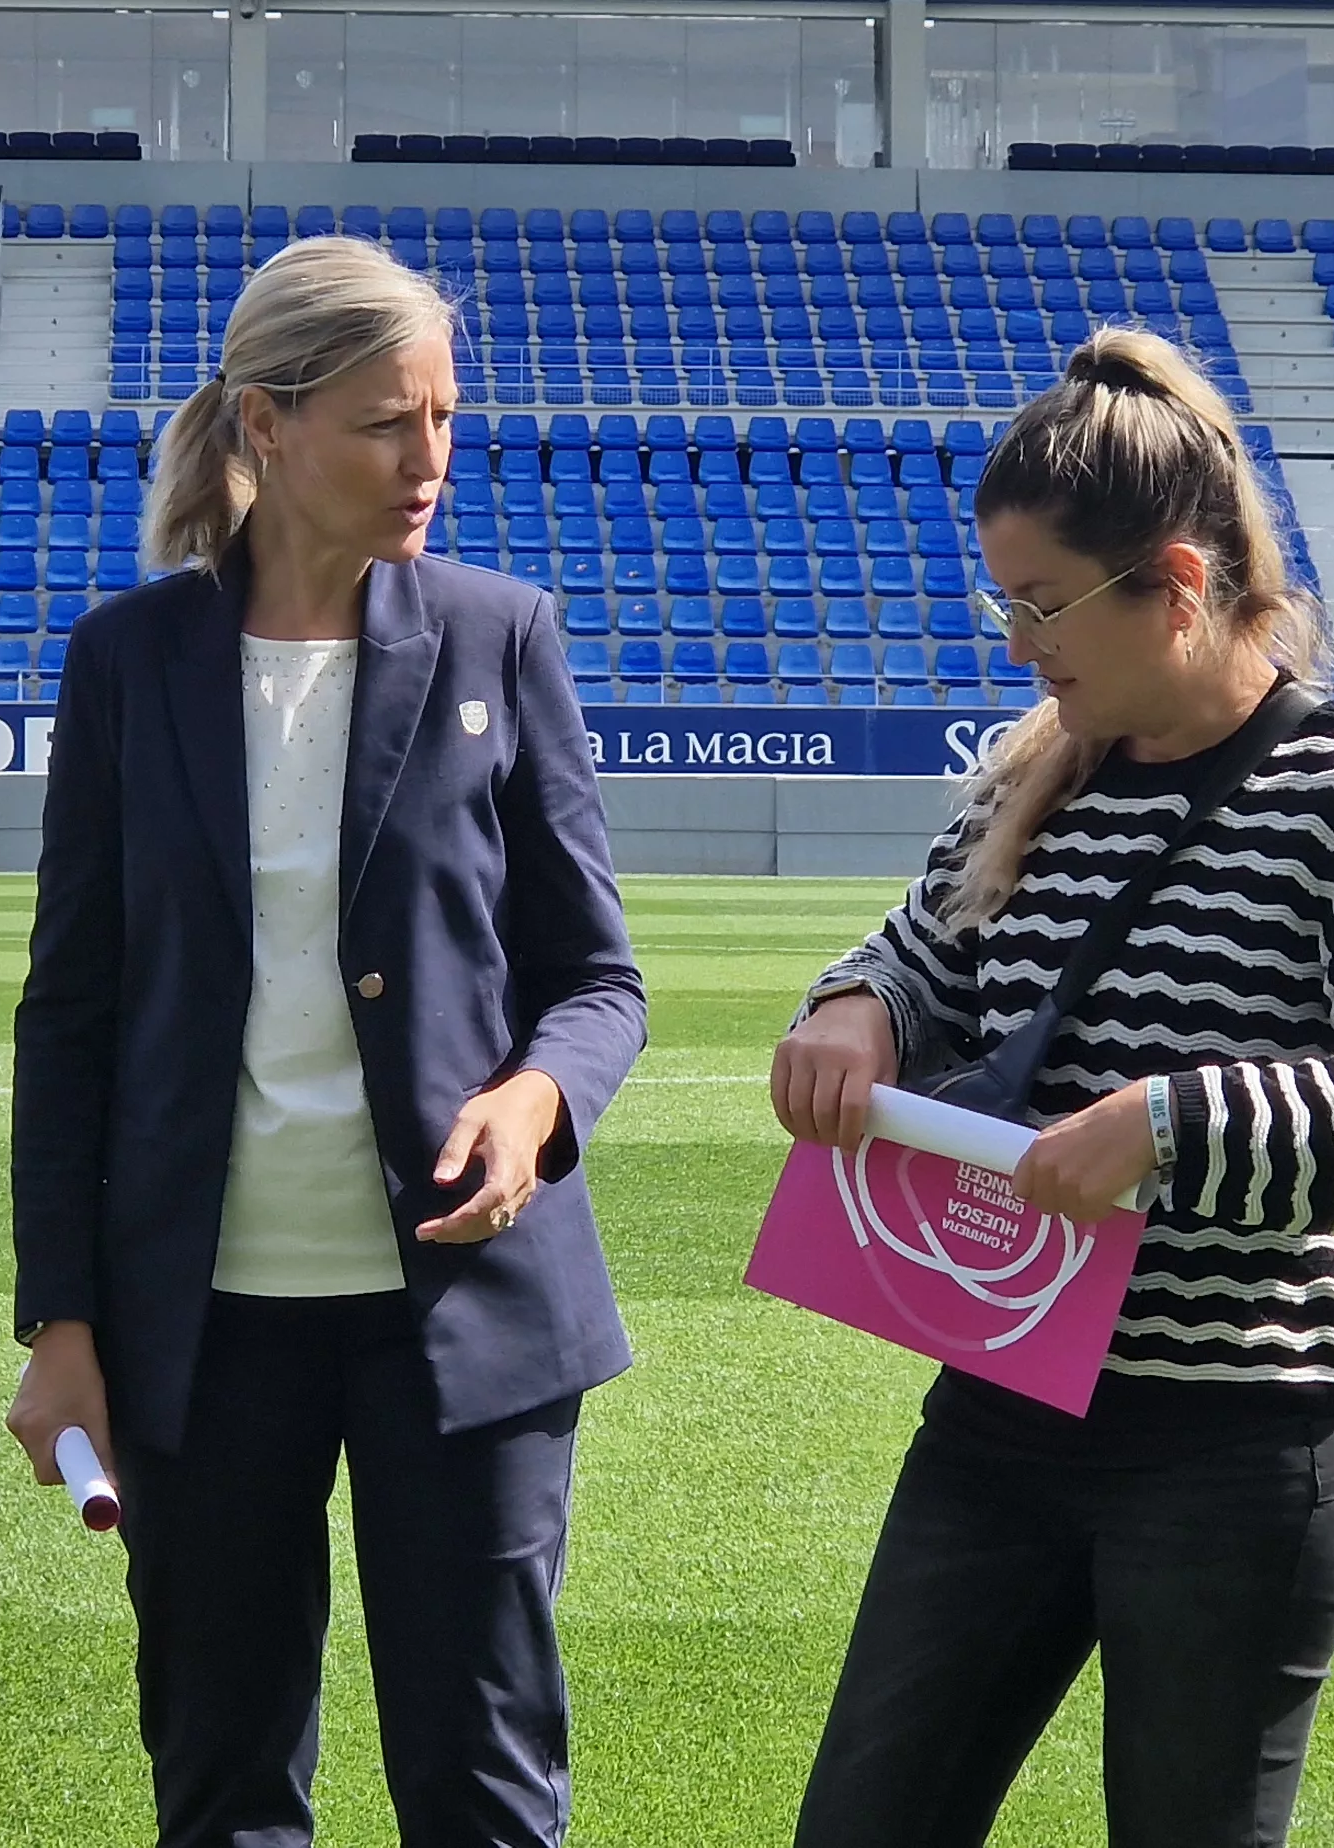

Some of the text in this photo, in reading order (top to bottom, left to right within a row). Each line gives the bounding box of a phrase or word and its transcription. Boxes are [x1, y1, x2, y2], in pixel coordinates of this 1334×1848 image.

[955, 1177, 1025, 1215] CONTRA EL
[957, 1162, 1026, 1202] ANCER
[942, 1217, 1013, 1254] X CARRERA
[947, 1198, 1020, 1239] HUESCA
